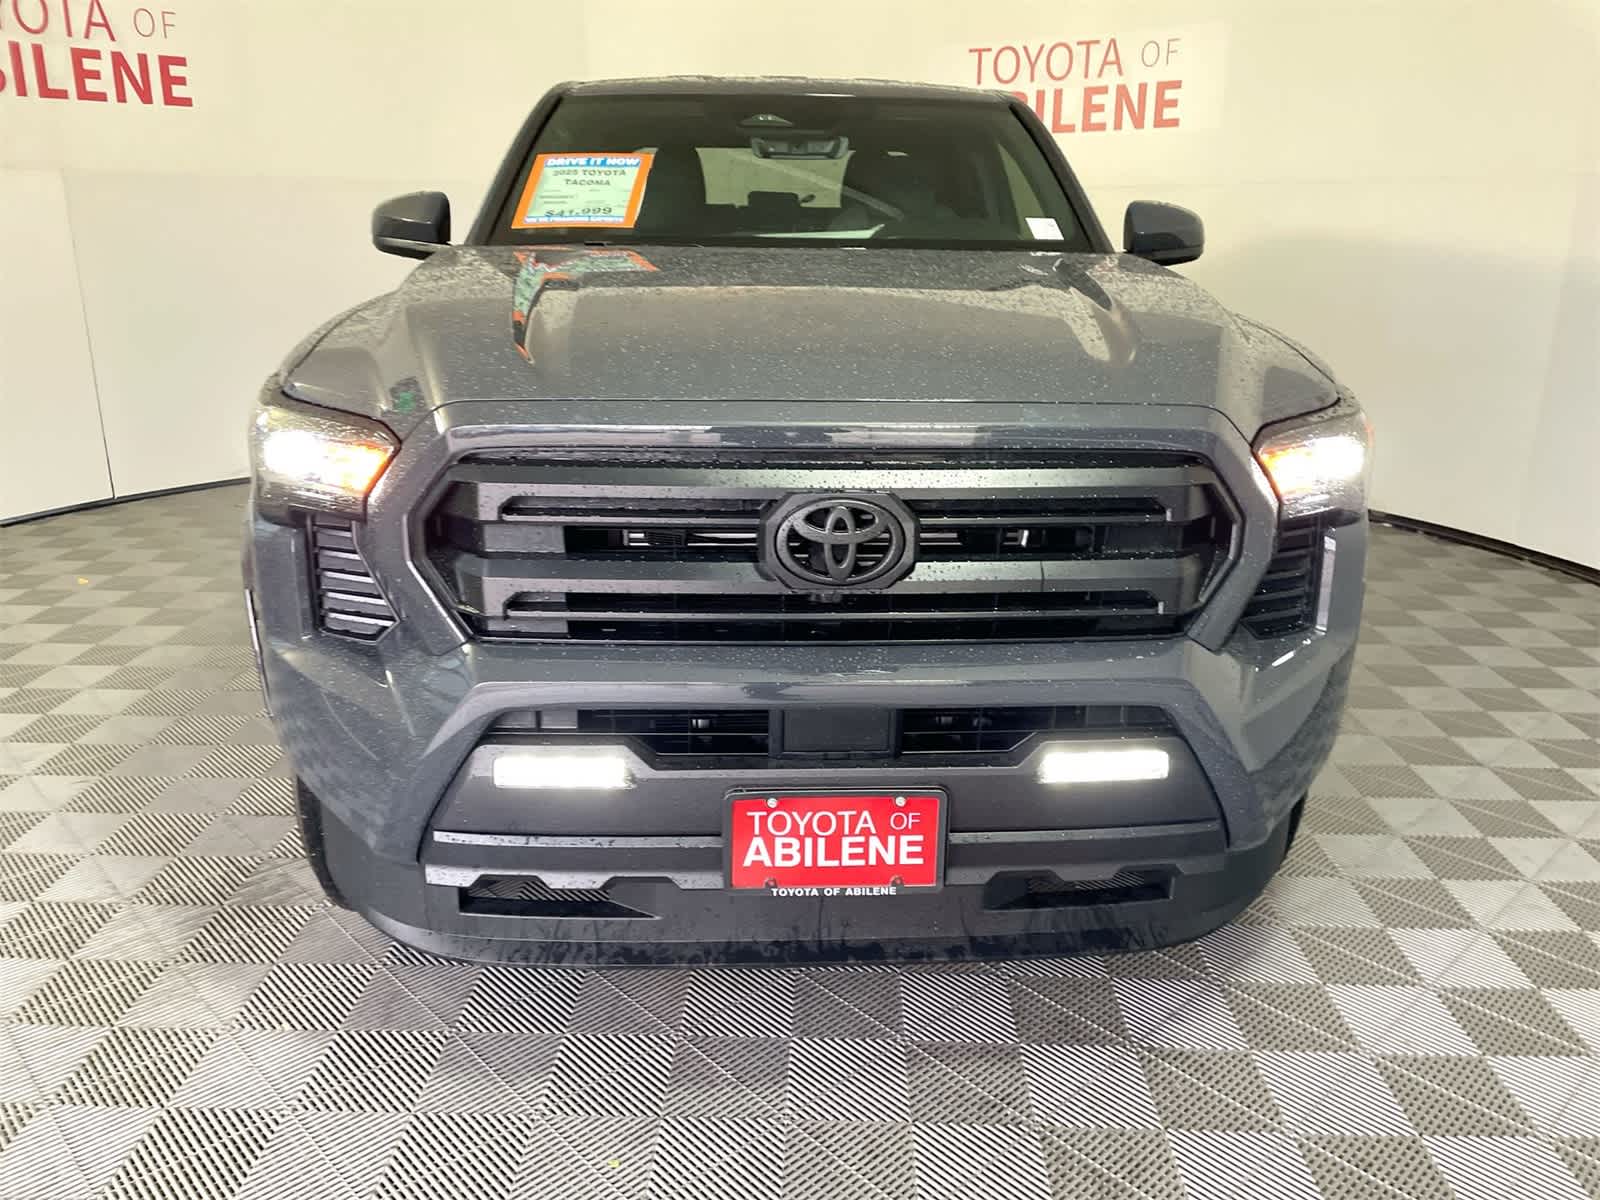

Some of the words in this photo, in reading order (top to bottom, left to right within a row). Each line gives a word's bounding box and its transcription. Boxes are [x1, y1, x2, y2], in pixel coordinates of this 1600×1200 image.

[133, 8, 176, 38] OF
[0, 40, 193, 107] ILENE
[969, 38, 1123, 85] TOYOTA
[1141, 38, 1181, 67] OF
[546, 157, 588, 166] DRIVE
[589, 157, 602, 166] IT
[606, 157, 640, 166] NOW
[582, 168, 627, 176] TOYOTA
[564, 178, 611, 186] TACOMA
[746, 810, 877, 836] TOYOTA
[889, 812, 921, 830] OF
[742, 835, 924, 868] ABILENE
[771, 887, 819, 897] TOYOTA
[824, 887, 840, 896] OF
[845, 886, 897, 896] ABILENE
